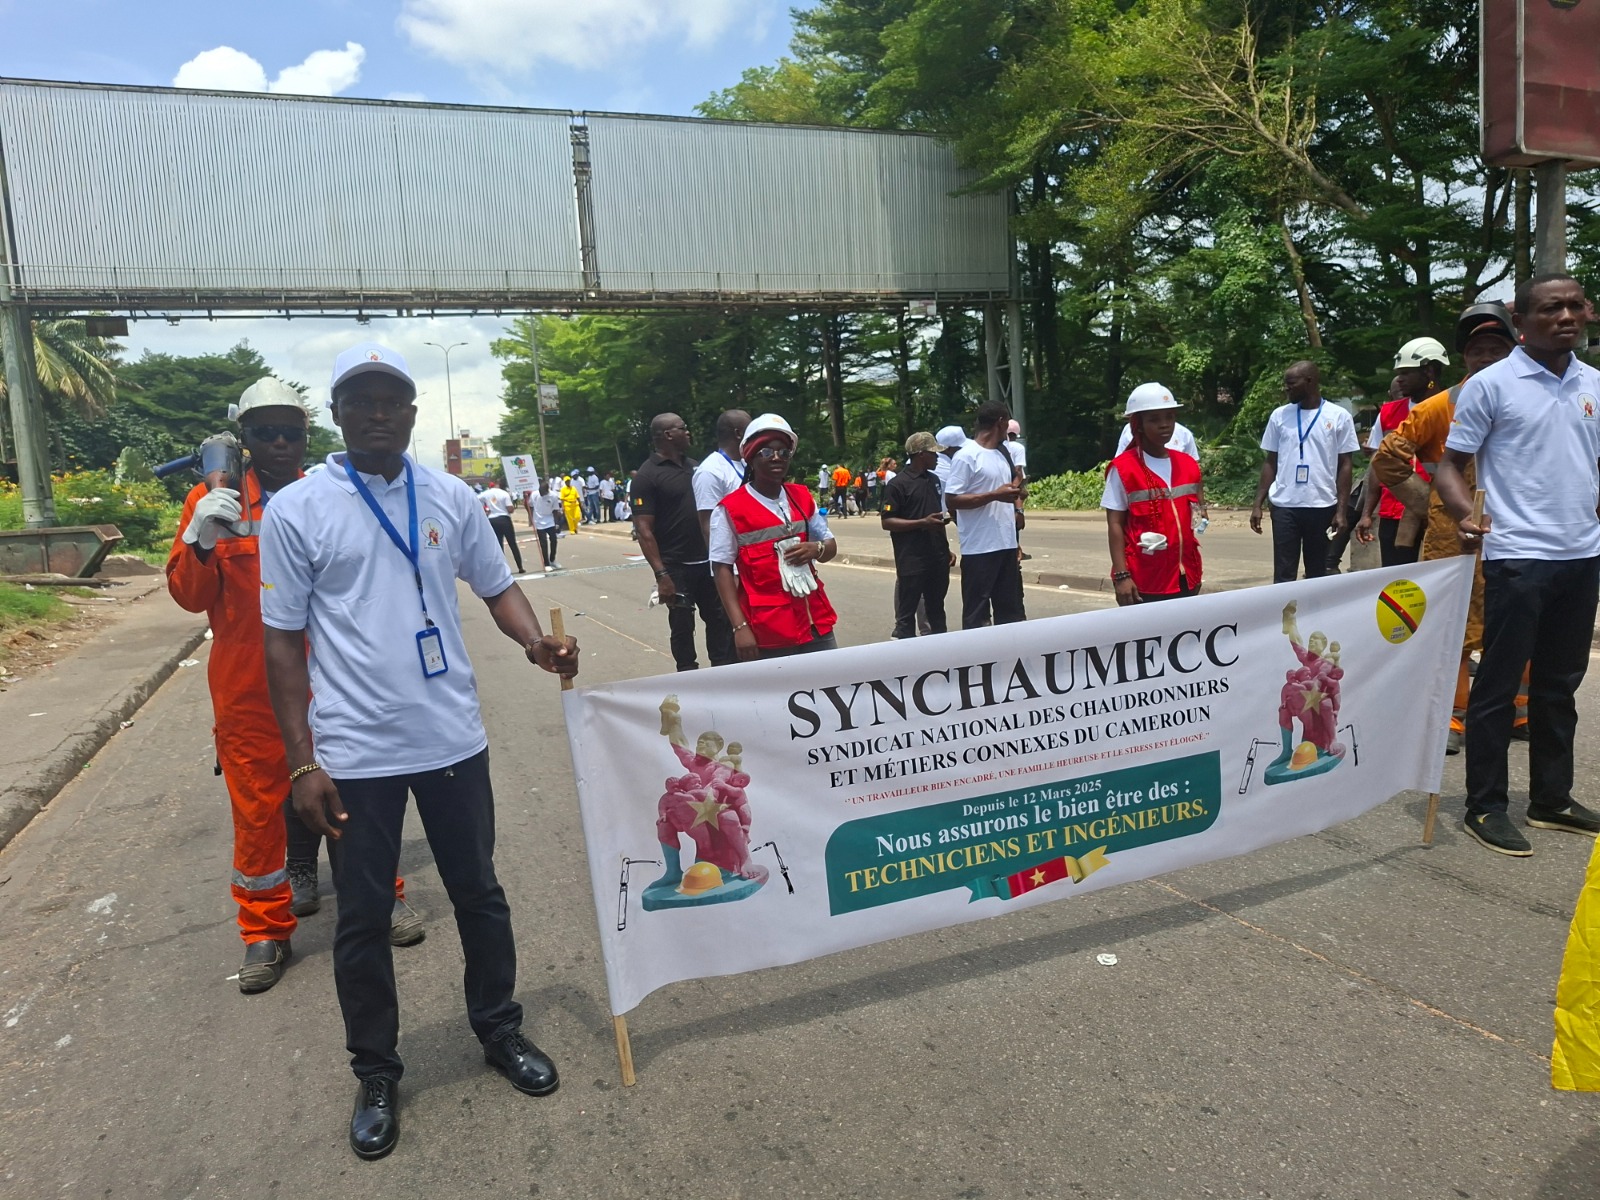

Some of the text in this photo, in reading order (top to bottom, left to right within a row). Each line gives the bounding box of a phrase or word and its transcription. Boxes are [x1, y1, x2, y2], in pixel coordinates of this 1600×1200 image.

[787, 622, 1240, 741] SYNCHAUMECC
[807, 677, 1230, 766] SYNDICAT NATIONAL DES CHAUDRONNIERS
[829, 705, 1211, 789] ET MÉTIERS CONNEXES DU CAMEROUN
[868, 784, 930, 803] TRAVAILLEUR
[931, 780, 952, 792] BIEN
[954, 771, 998, 788] ENCADRÉ,
[998, 768, 1016, 779] UNE
[1018, 760, 1055, 776] FAMILLE
[1056, 752, 1100, 768] HEUREUSE
[1100, 750, 1112, 760] ET
[1113, 748, 1124, 757] LE
[1124, 742, 1154, 755] STRESS
[1154, 739, 1168, 749] EST
[876, 831, 932, 858] Nous
[938, 812, 1029, 844] assurons
[1034, 804, 1052, 825] le
[1057, 797, 1100, 820] bien
[1105, 789, 1143, 810] être
[1148, 780, 1179, 801] des
[962, 779, 1102, 817] Depuis le 12 Mars 2025
[844, 798, 1209, 893] TECHNICIENS ET INGÉNIEURS.
